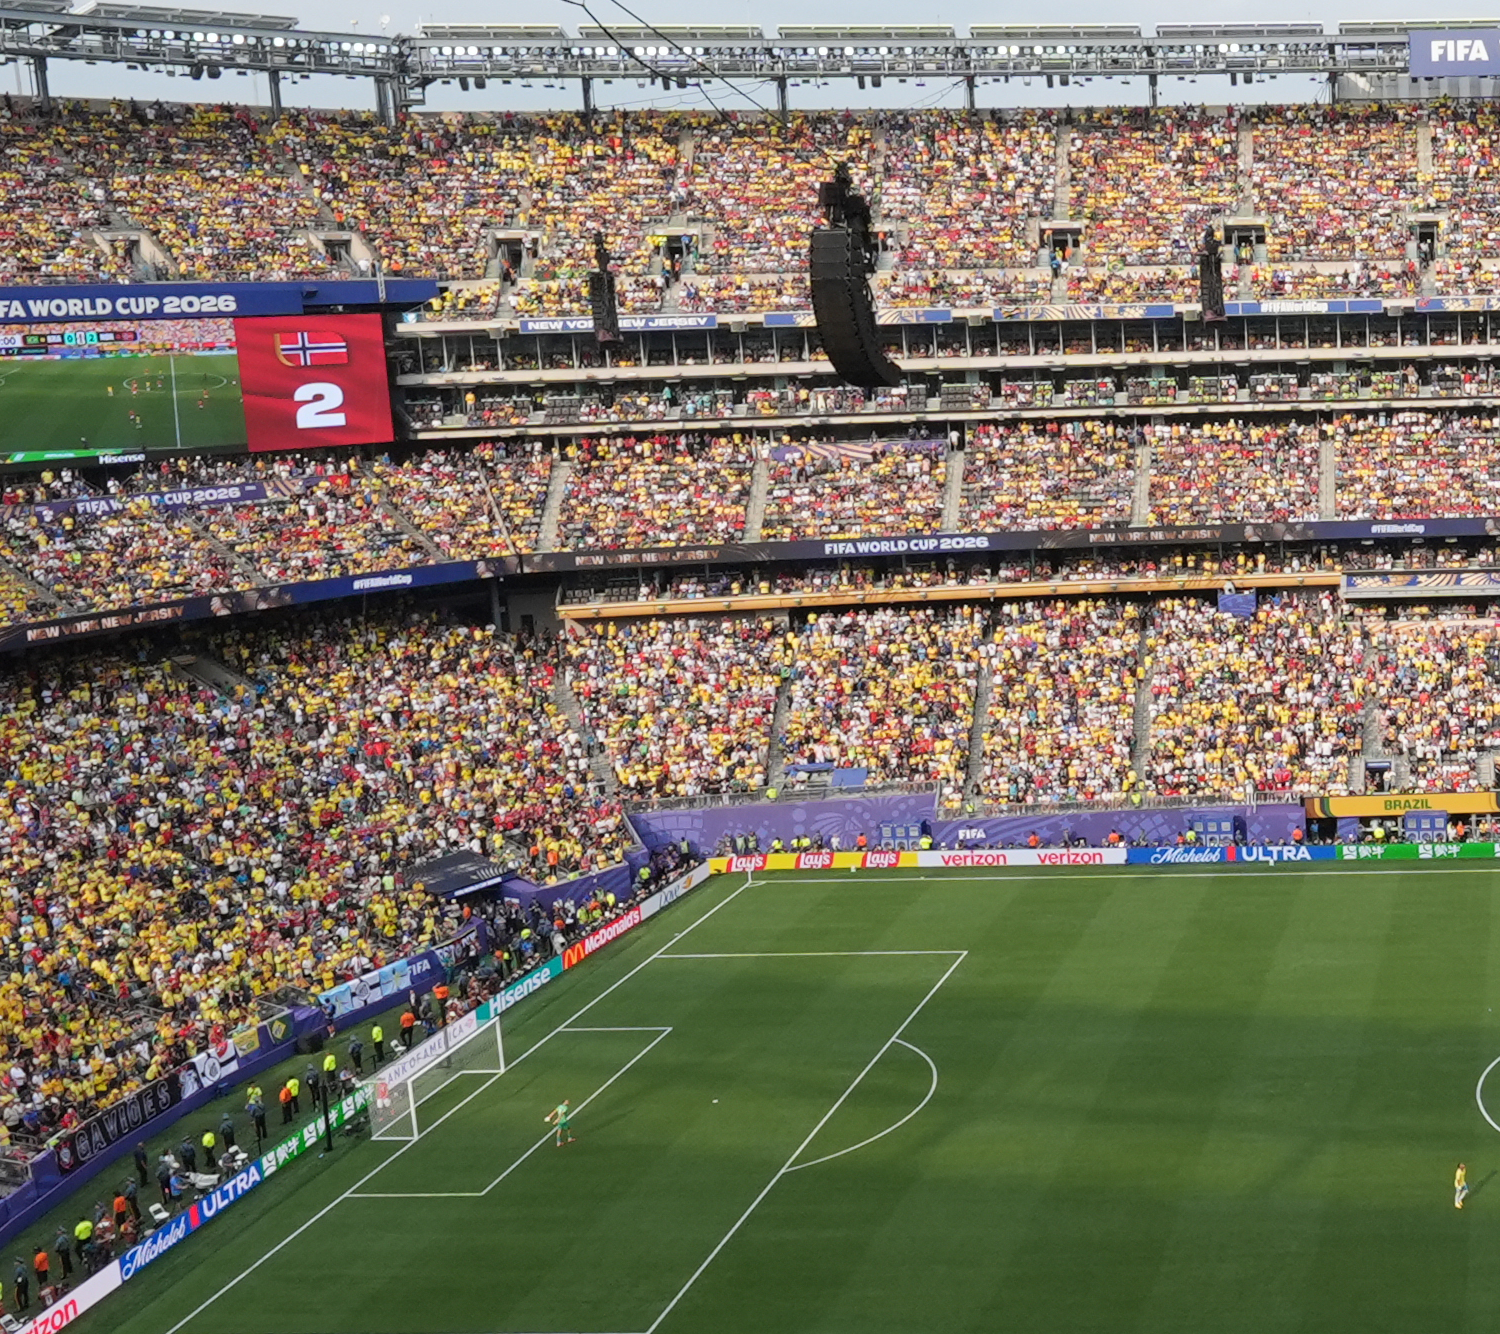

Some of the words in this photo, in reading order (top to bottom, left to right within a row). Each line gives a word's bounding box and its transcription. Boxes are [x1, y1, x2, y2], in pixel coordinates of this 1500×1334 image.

[1430, 40, 1489, 62] FIFA
[27, 298, 112, 317] WORLD
[114, 297, 159, 315] CUP
[162, 294, 237, 313] 2026
[528, 320, 561, 330] NEW
[648, 316, 707, 327] JERSEY
[293, 382, 347, 429] 2
[99, 453, 145, 465] Hisense
[76, 499, 109, 515] FIFA
[163, 492, 192, 504] CUP
[193, 486, 241, 502] 2026
[824, 542, 857, 555] FIFA
[857, 540, 908, 553] WORLD
[910, 539, 938, 551] CUP
[939, 536, 989, 549] 2026
[1384, 798, 1432, 811] BRAZIL
[958, 828, 986, 840] FIFA
[731, 854, 764, 871] Lay's
[799, 852, 832, 870] Lay's
[866, 851, 899, 868] Lay's
[941, 849, 1007, 866] verizon
[1037, 848, 1103, 865] verizon
[1150, 846, 1221, 864] Michelob
[1241, 845, 1312, 861] ULTRA
[585, 908, 640, 956] McDonald's
[488, 966, 551, 1016] Hisense
[122, 1210, 187, 1282] Michelob
[201, 1167, 260, 1219] ULTRA
